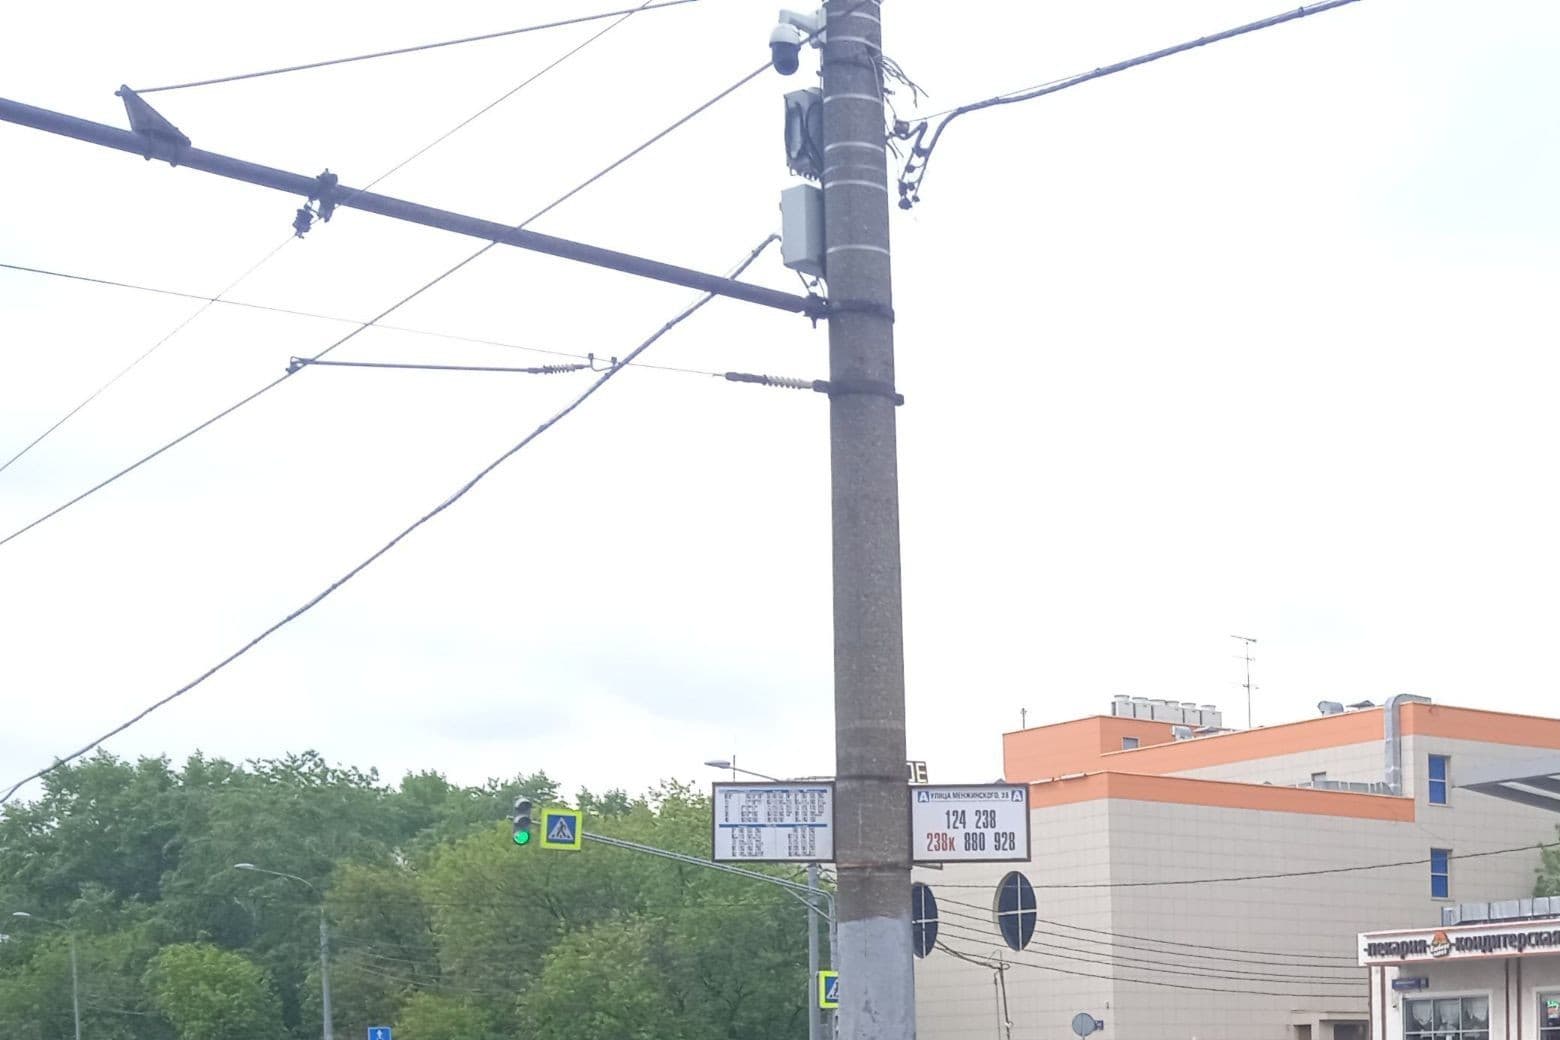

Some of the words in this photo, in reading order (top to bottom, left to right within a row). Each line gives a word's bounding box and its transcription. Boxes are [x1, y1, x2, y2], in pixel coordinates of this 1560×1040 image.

[930, 792, 951, 800] УЛИЦА
[945, 809, 967, 829] 124
[975, 809, 996, 829] 238
[964, 832, 985, 851] 880
[994, 831, 1015, 851] 928
